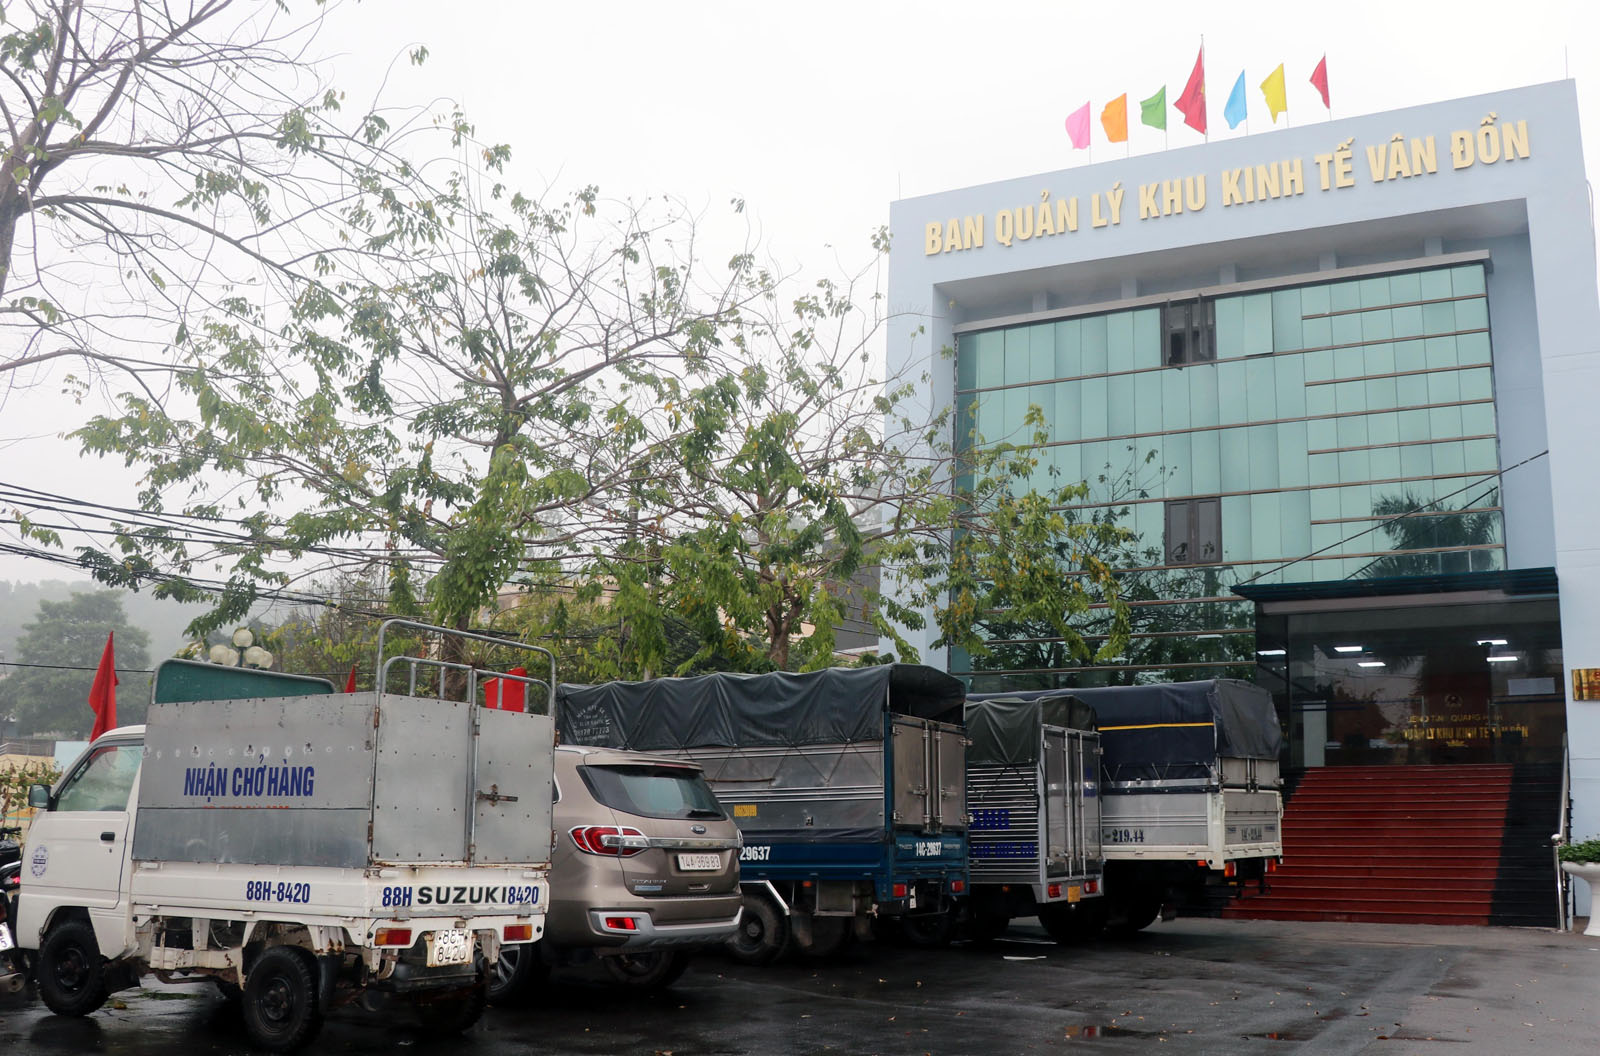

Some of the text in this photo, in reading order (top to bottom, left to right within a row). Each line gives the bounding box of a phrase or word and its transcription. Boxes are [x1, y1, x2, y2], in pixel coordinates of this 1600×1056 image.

[925, 111, 1531, 256] BAN QUẢN LÝ KHU KINH TẾ VÂN ĐỒN
[184, 754, 315, 802] NHẬN CHỞ HÀNG
[1102, 828, 1145, 843] -219.44
[739, 846, 771, 861] 29637
[246, 880, 311, 904] 88H-8420
[382, 886, 540, 907] 88H SUZUKI 8420
[438, 945, 466, 962] 8420
